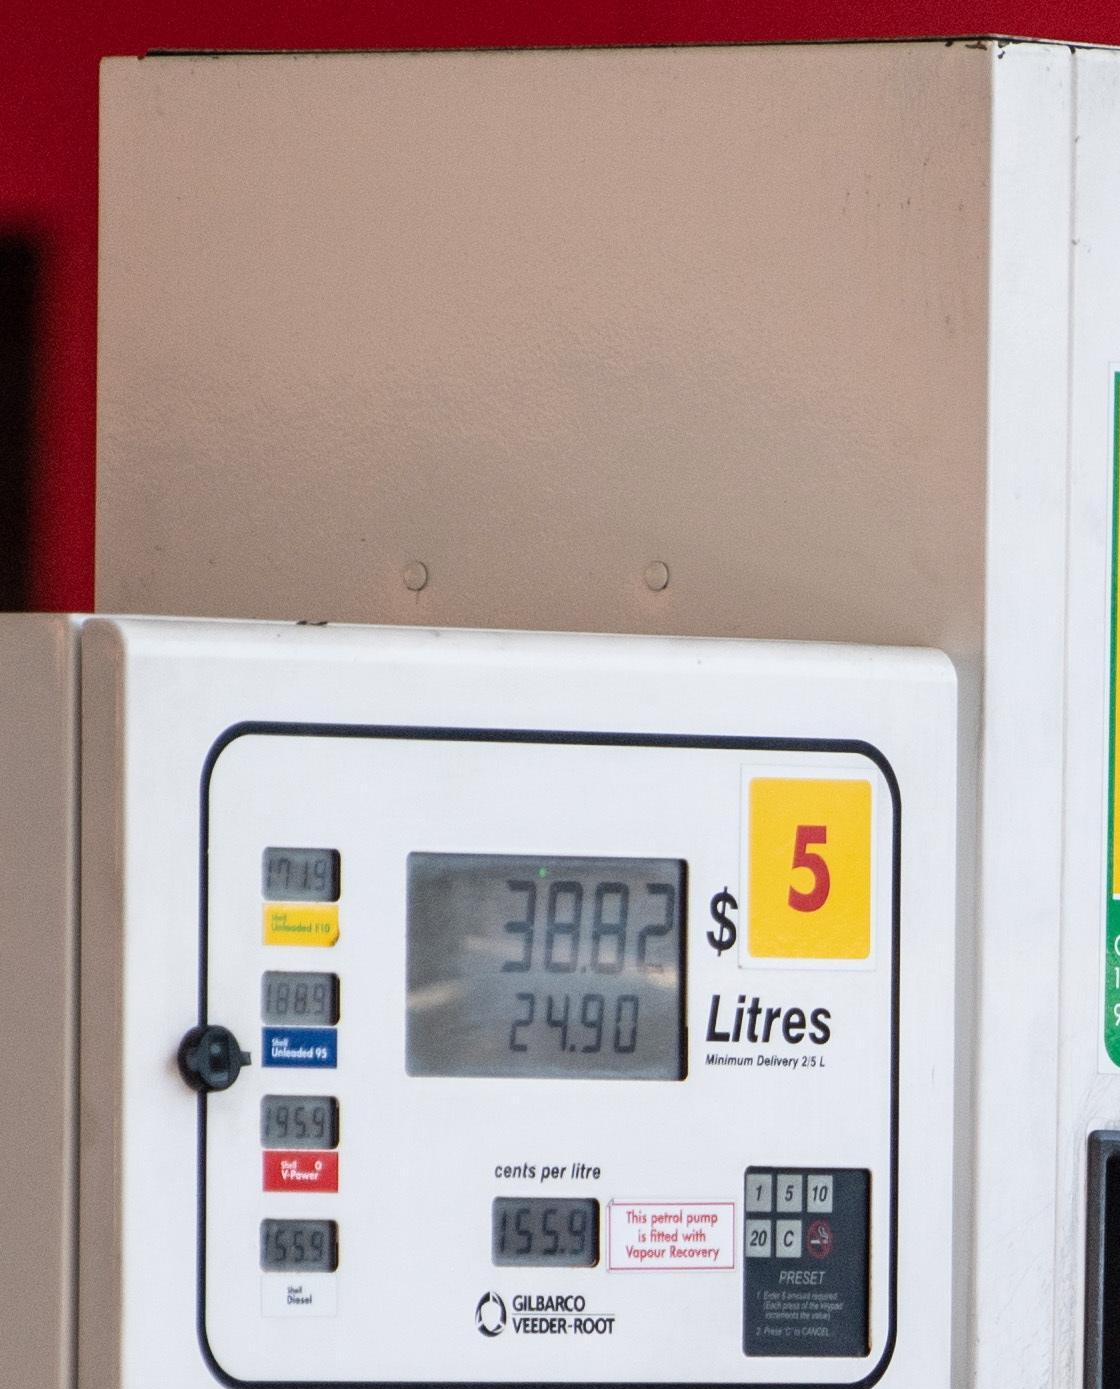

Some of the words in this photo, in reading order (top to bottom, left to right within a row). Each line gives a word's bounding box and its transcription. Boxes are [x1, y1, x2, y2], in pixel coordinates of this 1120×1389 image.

[787, 825, 831, 913] 5
[500, 880, 675, 975] 38.82
[706, 886, 738, 957] $
[509, 993, 639, 1054] 24.90
[706, 994, 832, 1045] Litres
[271, 1047, 313, 1059] Unleaded
[316, 1048, 328, 1060] 95
[705, 1053, 753, 1067] Minimum
[757, 1055, 798, 1070] Delivery
[819, 1056, 826, 1068] L
[281, 1170, 319, 1181] V-Power
[495, 1163, 536, 1179] cents
[541, 1165, 566, 1183] per
[571, 1163, 601, 1180] litre
[756, 1185, 762, 1201] 1
[785, 1185, 794, 1201] 5
[812, 1185, 829, 1201] 10
[626, 1209, 647, 1224] This
[651, 1209, 683, 1228] petrol
[687, 1213, 718, 1228] pump
[638, 1230, 646, 1242] is
[650, 1229, 678, 1242] fitted
[682, 1229, 706, 1242] with
[750, 1230, 768, 1246] 20
[783, 1230, 794, 1247] C
[626, 1245, 666, 1262] Vapour
[669, 1245, 720, 1262] Recovery
[779, 1271, 826, 1285] PRESET
[287, 1295, 312, 1305] Diesel
[512, 1295, 586, 1312] GILBARCO
[512, 1317, 616, 1335] VEEDER-ROOT
